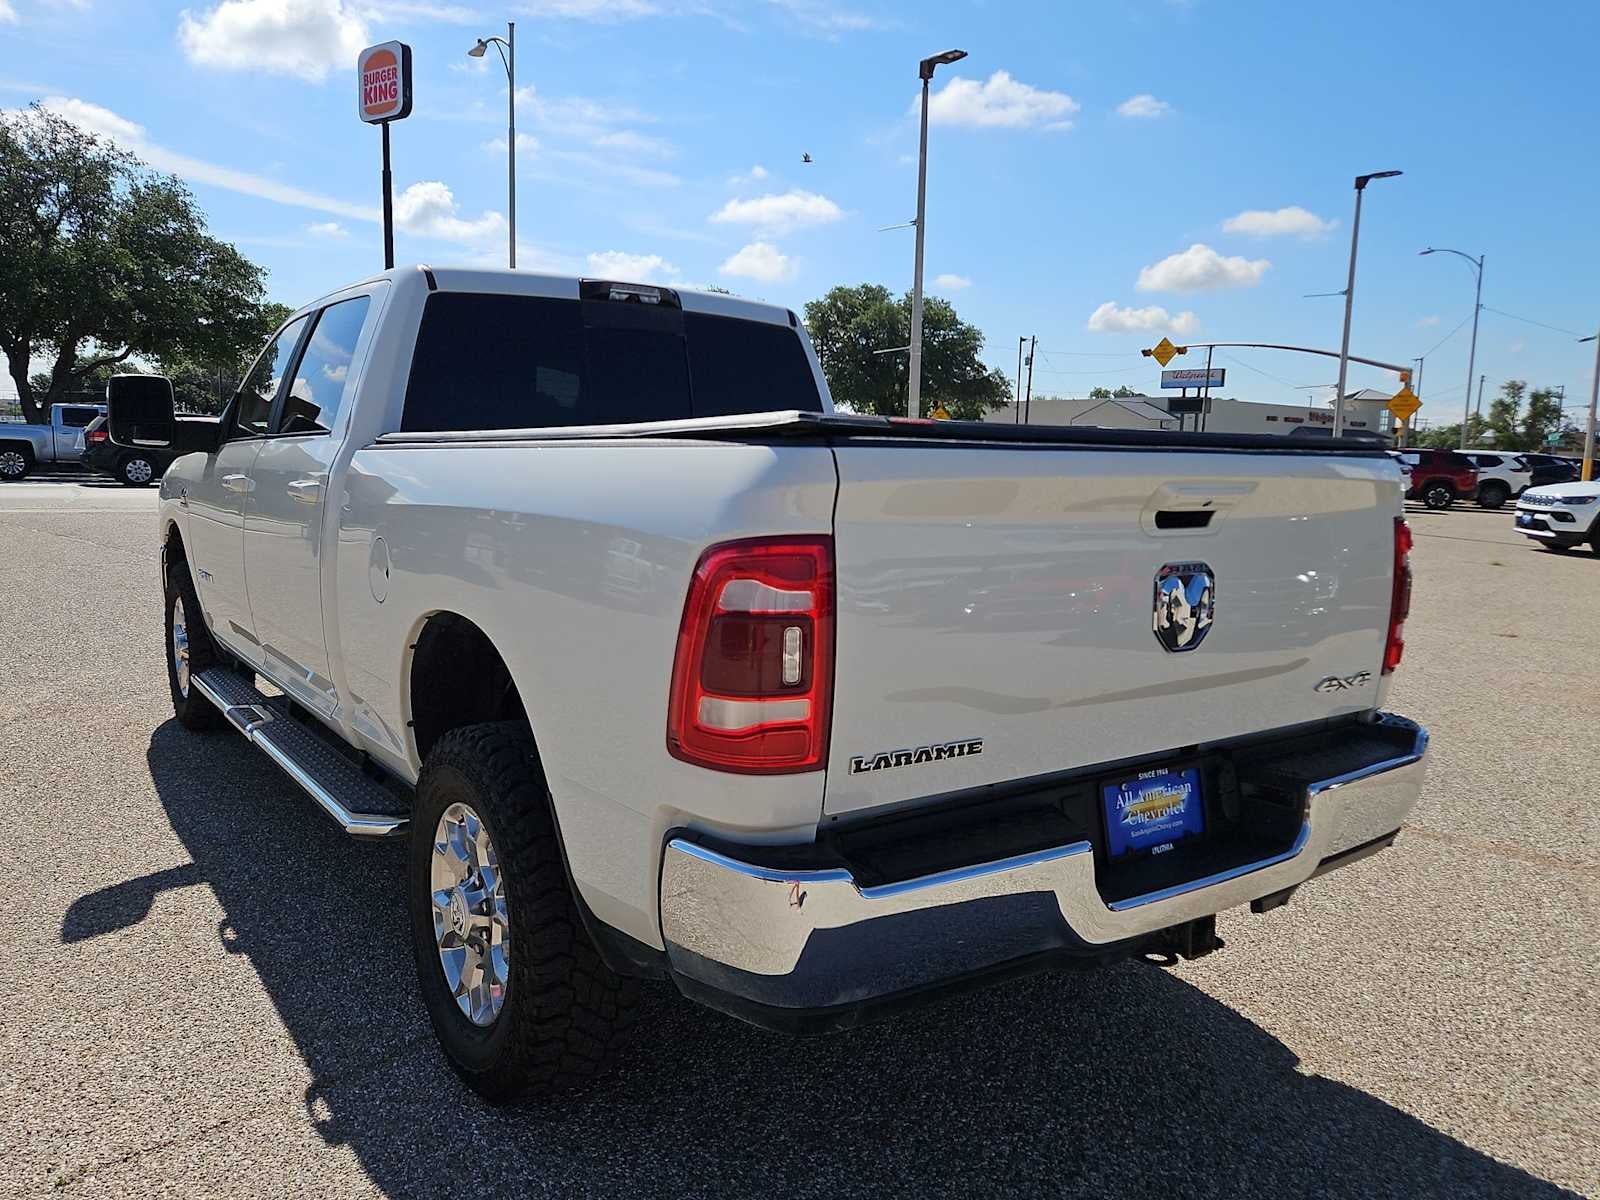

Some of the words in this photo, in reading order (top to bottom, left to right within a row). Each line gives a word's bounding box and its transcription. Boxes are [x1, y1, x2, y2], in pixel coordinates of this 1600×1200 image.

[364, 67, 397, 87] BURGER
[364, 81, 398, 106] KING
[849, 738, 983, 774] LARAMIE
[1138, 769, 1156, 780] SINCE
[1116, 790, 1135, 810] All
[1135, 782, 1192, 804] American
[1128, 800, 1185, 825] Chevrolet
